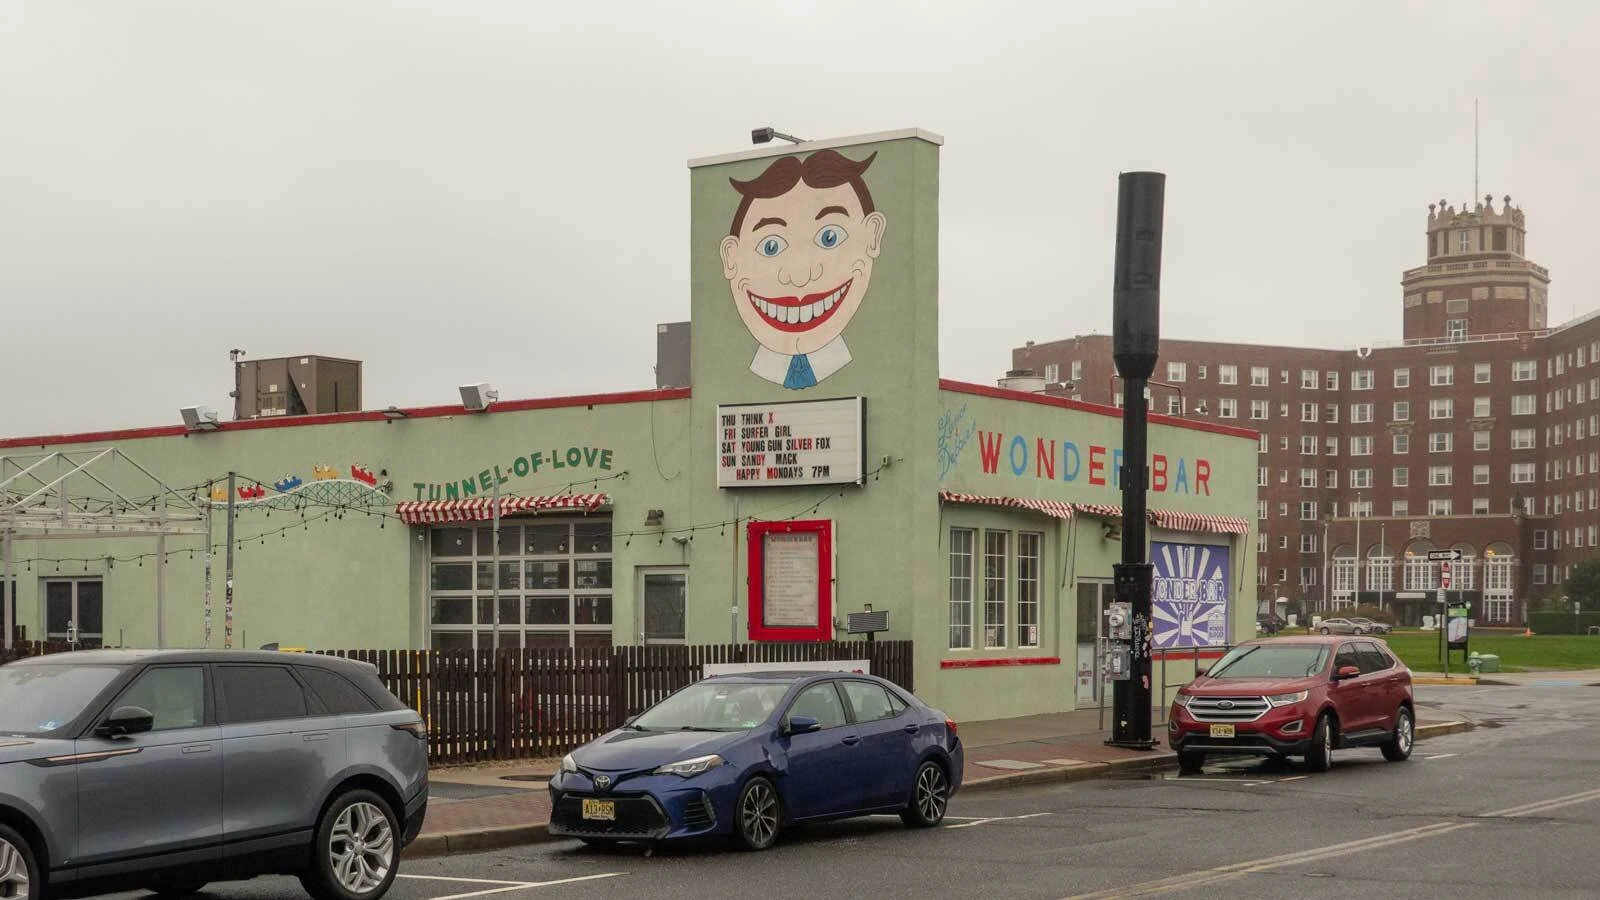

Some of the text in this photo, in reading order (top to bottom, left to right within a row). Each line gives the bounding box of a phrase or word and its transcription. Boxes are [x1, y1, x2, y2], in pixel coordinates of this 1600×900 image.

[721, 412, 774, 426] THU THINK X
[724, 425, 792, 440] FRI SURFER GIRL
[721, 437, 831, 454] SAT YOUNG GUN SILVER FOX
[721, 453, 798, 467] SUN SANDY MACK
[736, 465, 830, 481] HAPPY MONDAYS 7PM
[1152, 454, 1210, 496] BAR
[1200, 579, 1225, 604] BAR
